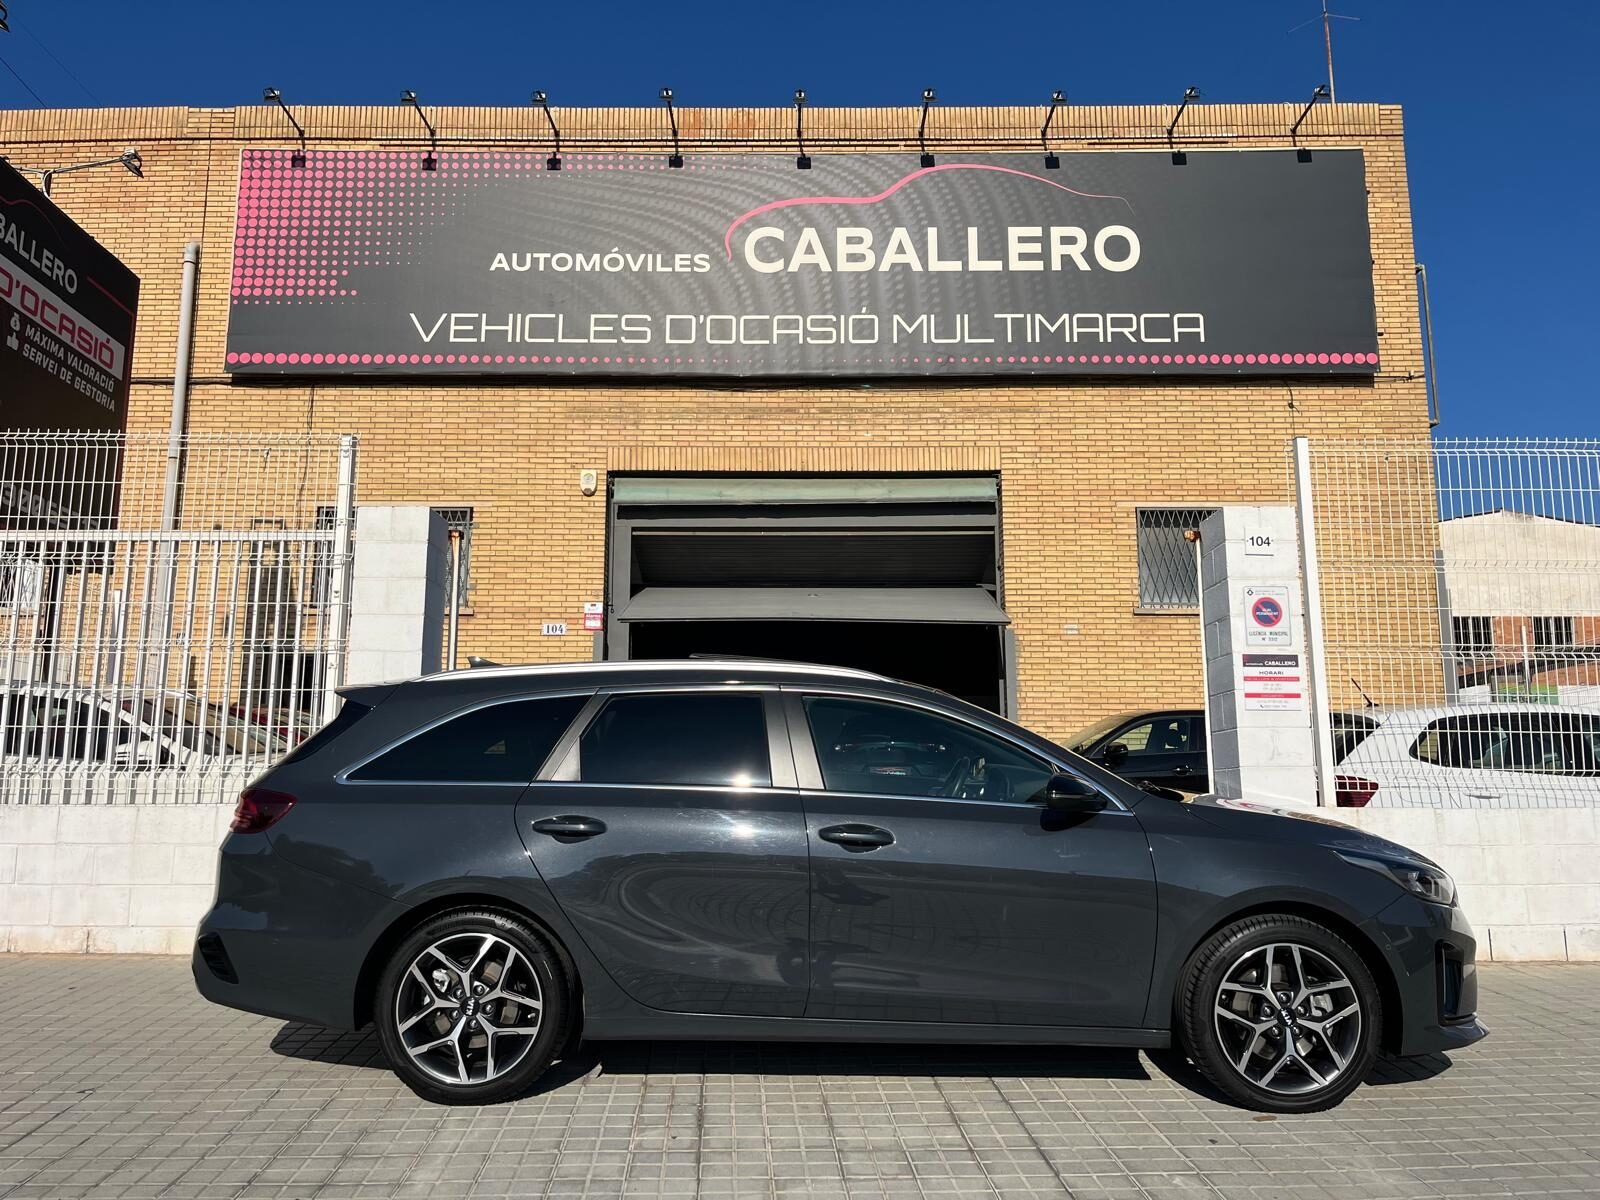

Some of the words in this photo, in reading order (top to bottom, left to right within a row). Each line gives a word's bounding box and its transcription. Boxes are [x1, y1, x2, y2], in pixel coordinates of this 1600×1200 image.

[489, 247, 711, 273] AUTOMÓVILES
[744, 225, 1141, 274] CABALLERO
[409, 312, 652, 344] VEHICLES
[665, 307, 880, 346] D'OCASIÓ
[892, 312, 1206, 344] MULTIMARCA
[22, 343, 58, 375] SERVEI
[60, 367, 73, 384] DE
[74, 376, 115, 412] GESTORIA
[25, 324, 64, 360] MÀXIMA
[67, 351, 114, 393] VALORACIÓ
[1249, 536, 1271, 547] 104
[546, 624, 564, 634] 104
